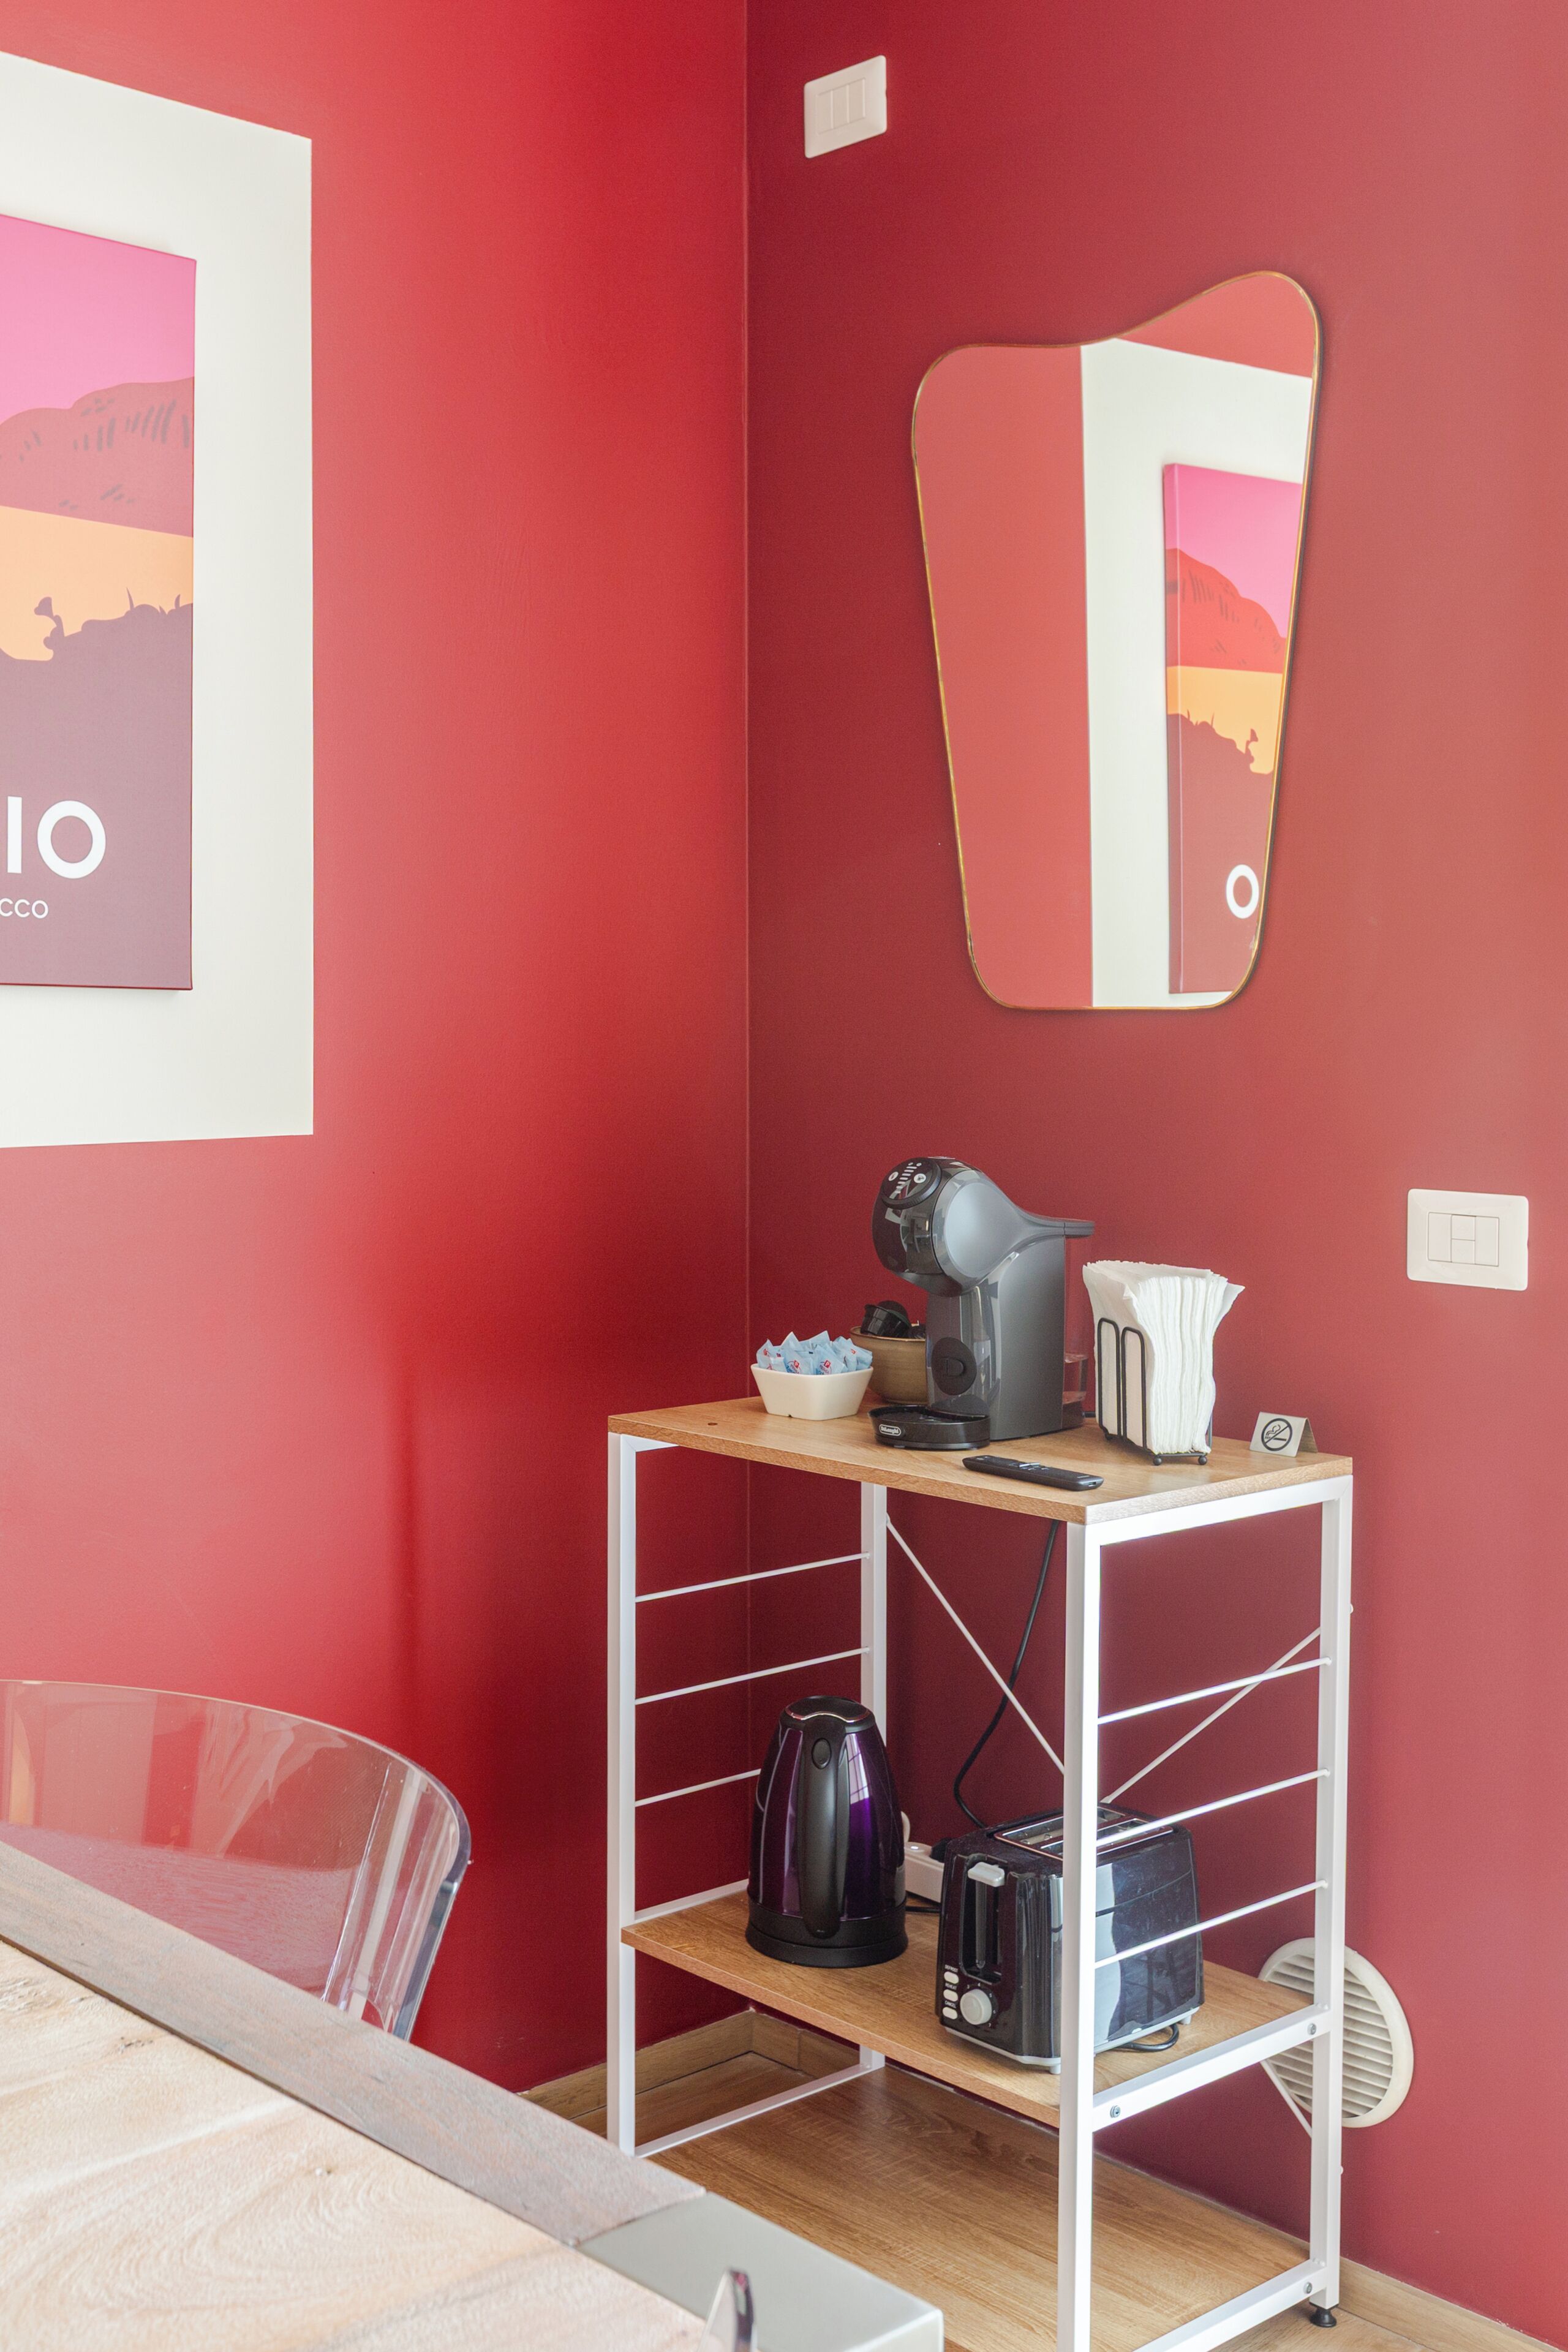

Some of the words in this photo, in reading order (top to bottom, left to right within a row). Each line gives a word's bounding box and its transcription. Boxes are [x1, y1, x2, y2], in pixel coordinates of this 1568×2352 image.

[7, 796, 107, 880] IO
[0, 898, 48, 919] CCO
[944, 1964, 959, 1973] DEFROST
[944, 2000, 956, 2009] CANCEL
